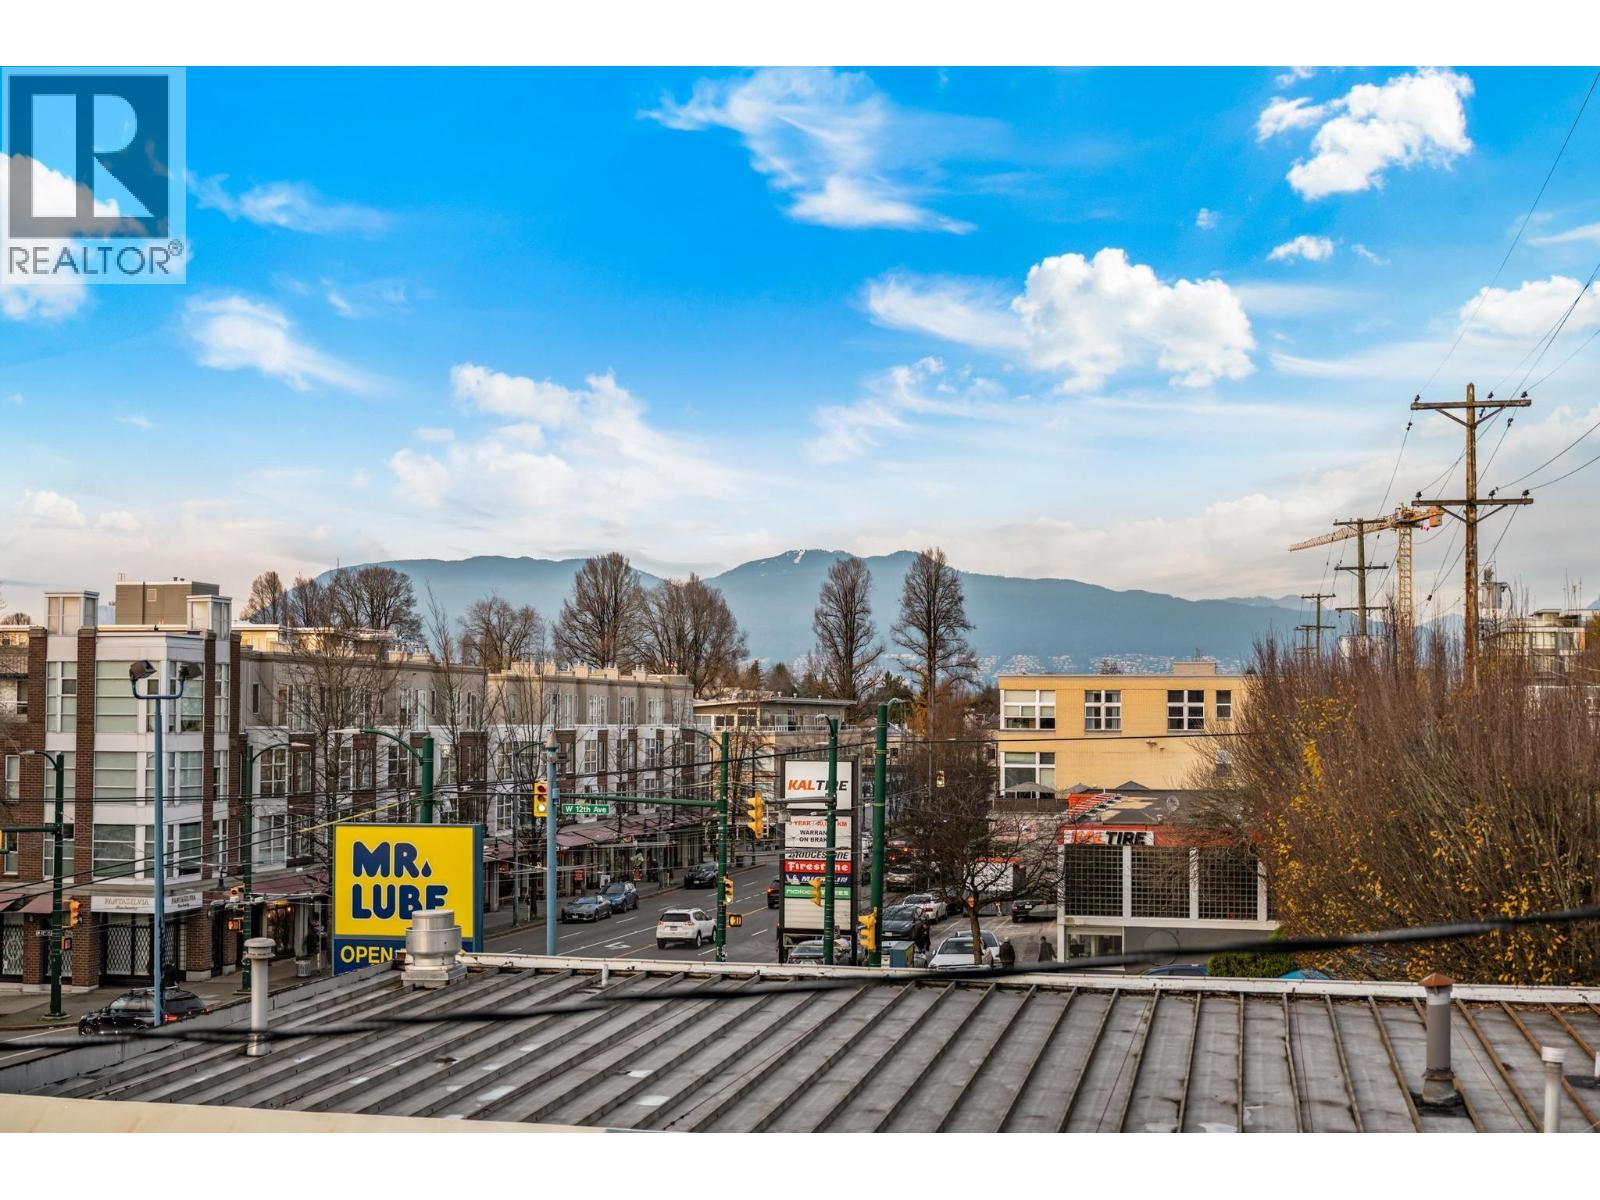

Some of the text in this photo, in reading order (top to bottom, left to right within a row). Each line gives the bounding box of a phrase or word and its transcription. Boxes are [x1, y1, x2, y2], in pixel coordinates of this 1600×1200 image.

[1106, 831, 1147, 846] TIRE
[788, 861, 849, 872] Firestne
[340, 945, 393, 965] OPEN
